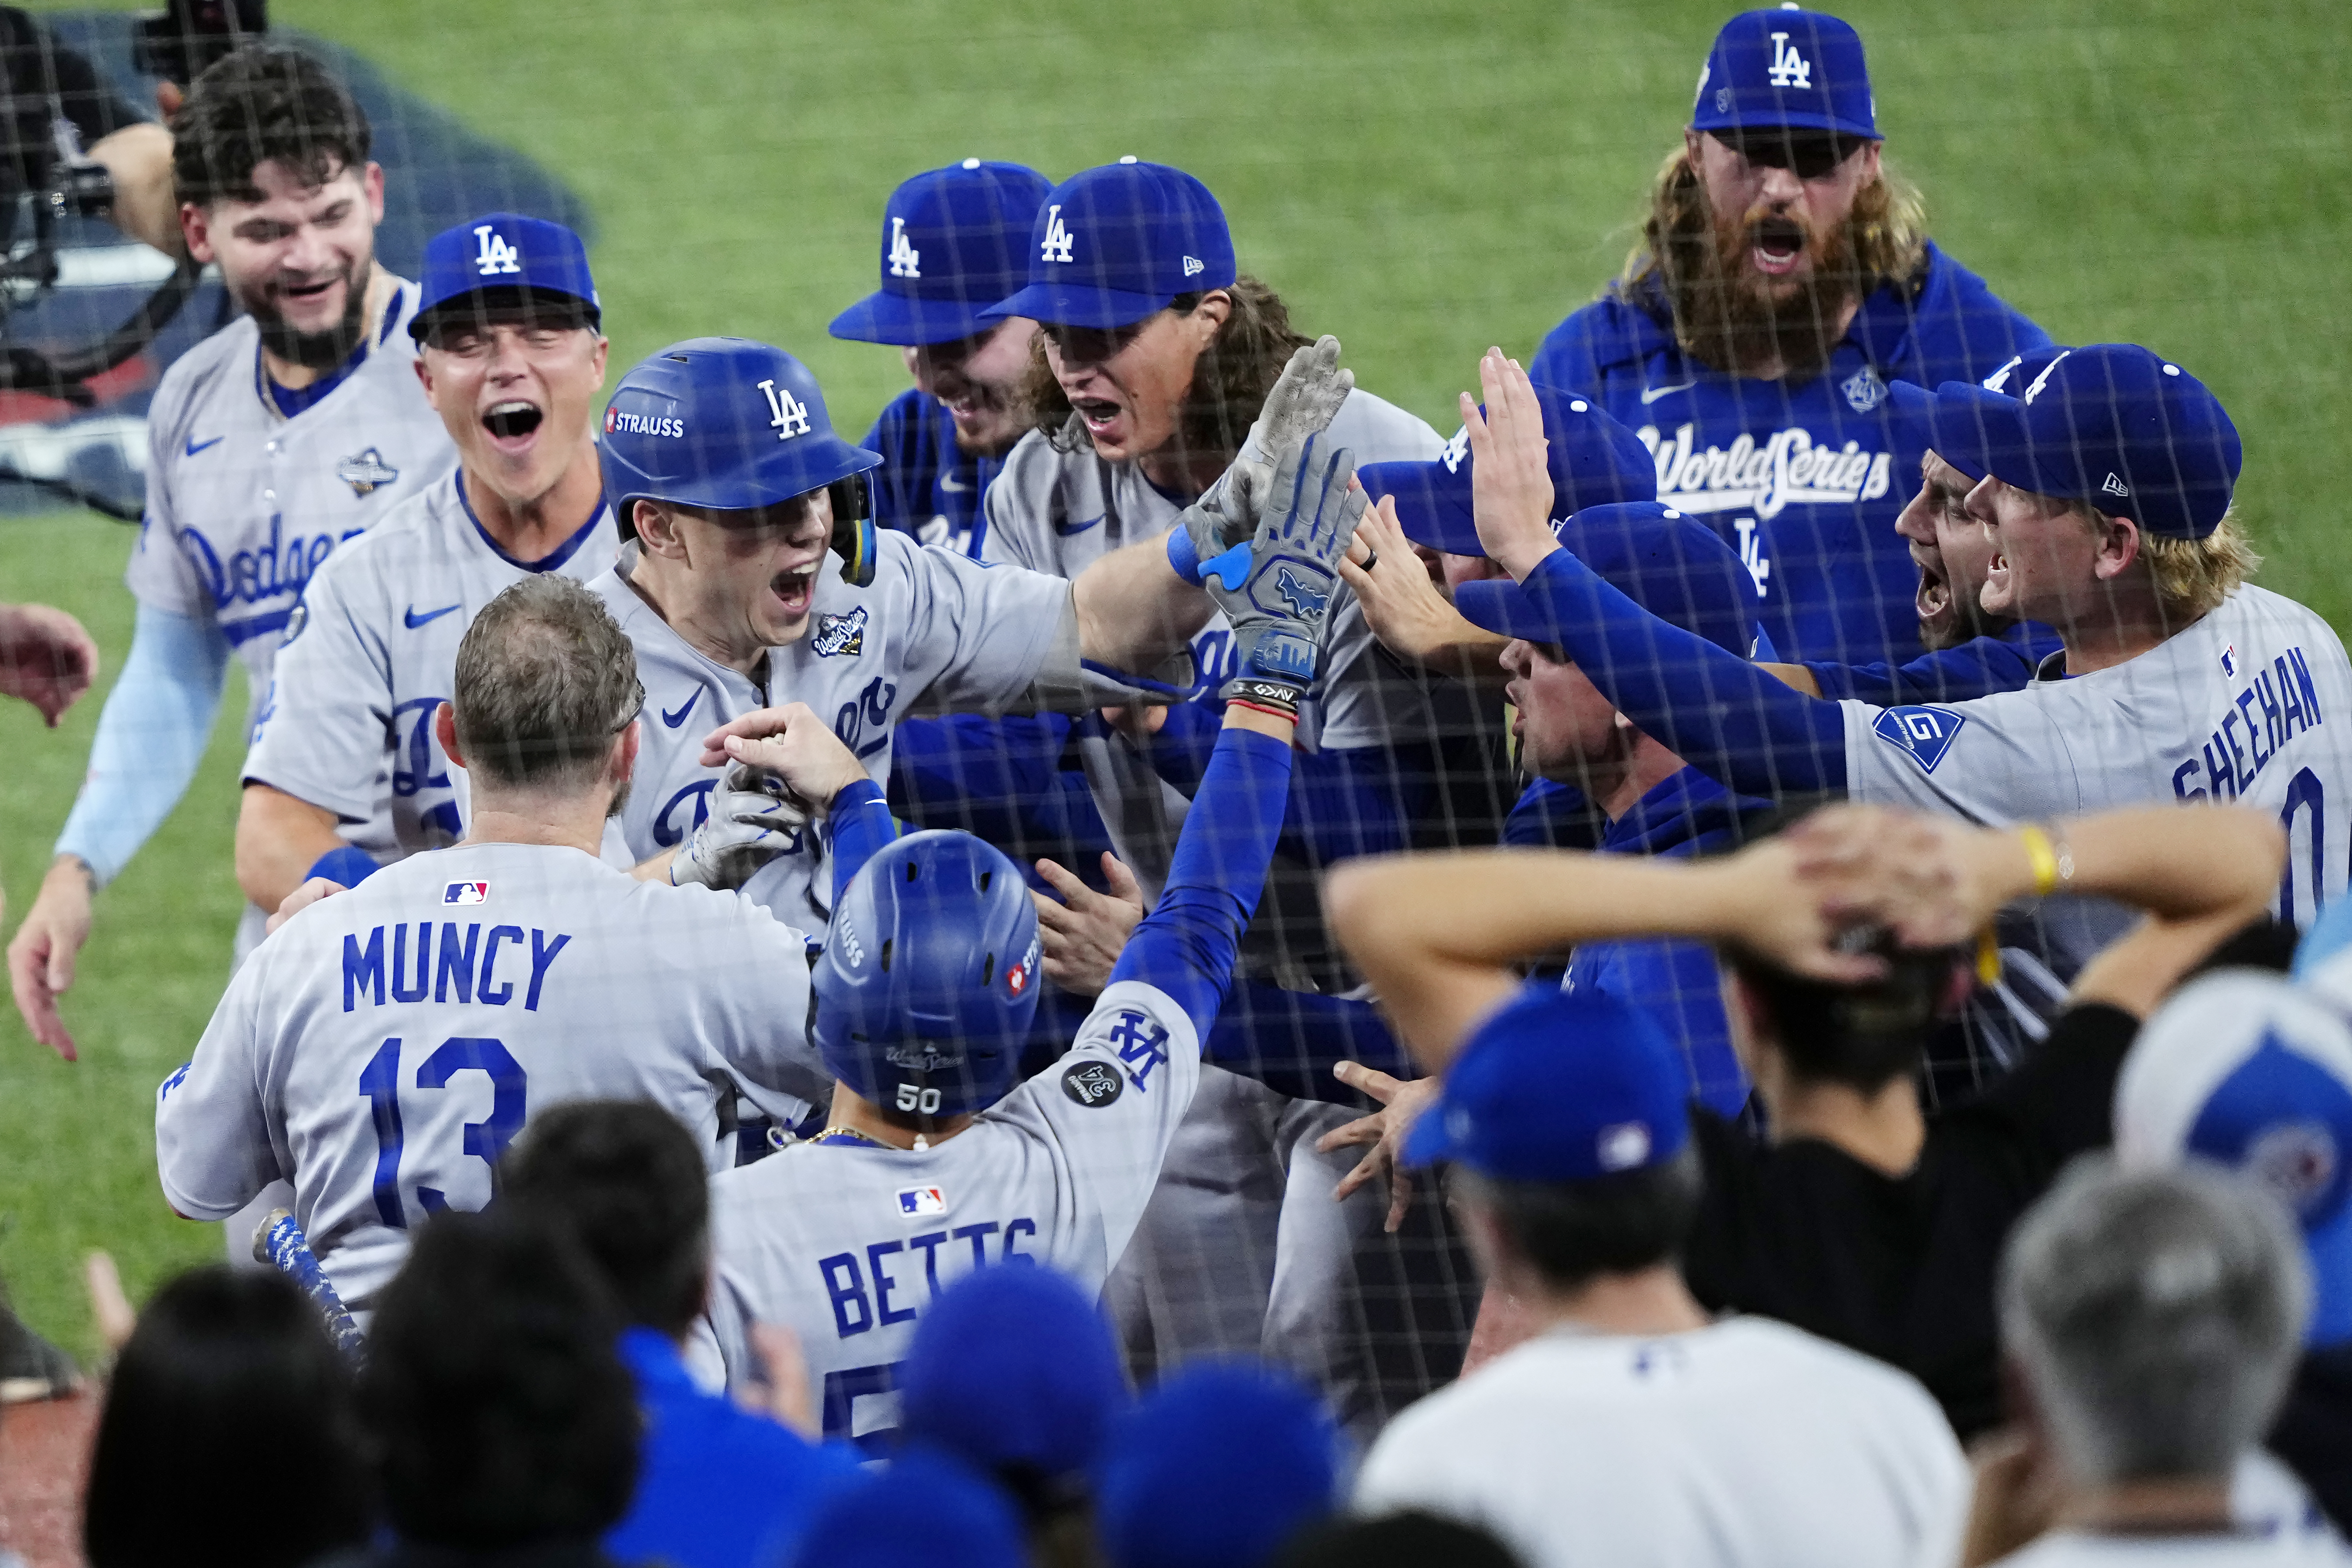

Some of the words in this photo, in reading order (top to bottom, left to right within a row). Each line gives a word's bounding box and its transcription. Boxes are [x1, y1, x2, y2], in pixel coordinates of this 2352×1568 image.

[1768, 32, 1811, 89] LA
[473, 225, 521, 275] LA
[888, 217, 921, 278] LA
[1041, 205, 1074, 262] LA
[616, 412, 683, 438] STRAUSS
[757, 379, 811, 440] LA
[174, 511, 365, 610] Dodge
[2172, 647, 2322, 805] SHEEHAN
[343, 921, 573, 1012] MUNCY
[896, 1083, 942, 1115] 50
[1077, 1064, 1117, 1098] 34
[359, 1036, 528, 1229] 13
